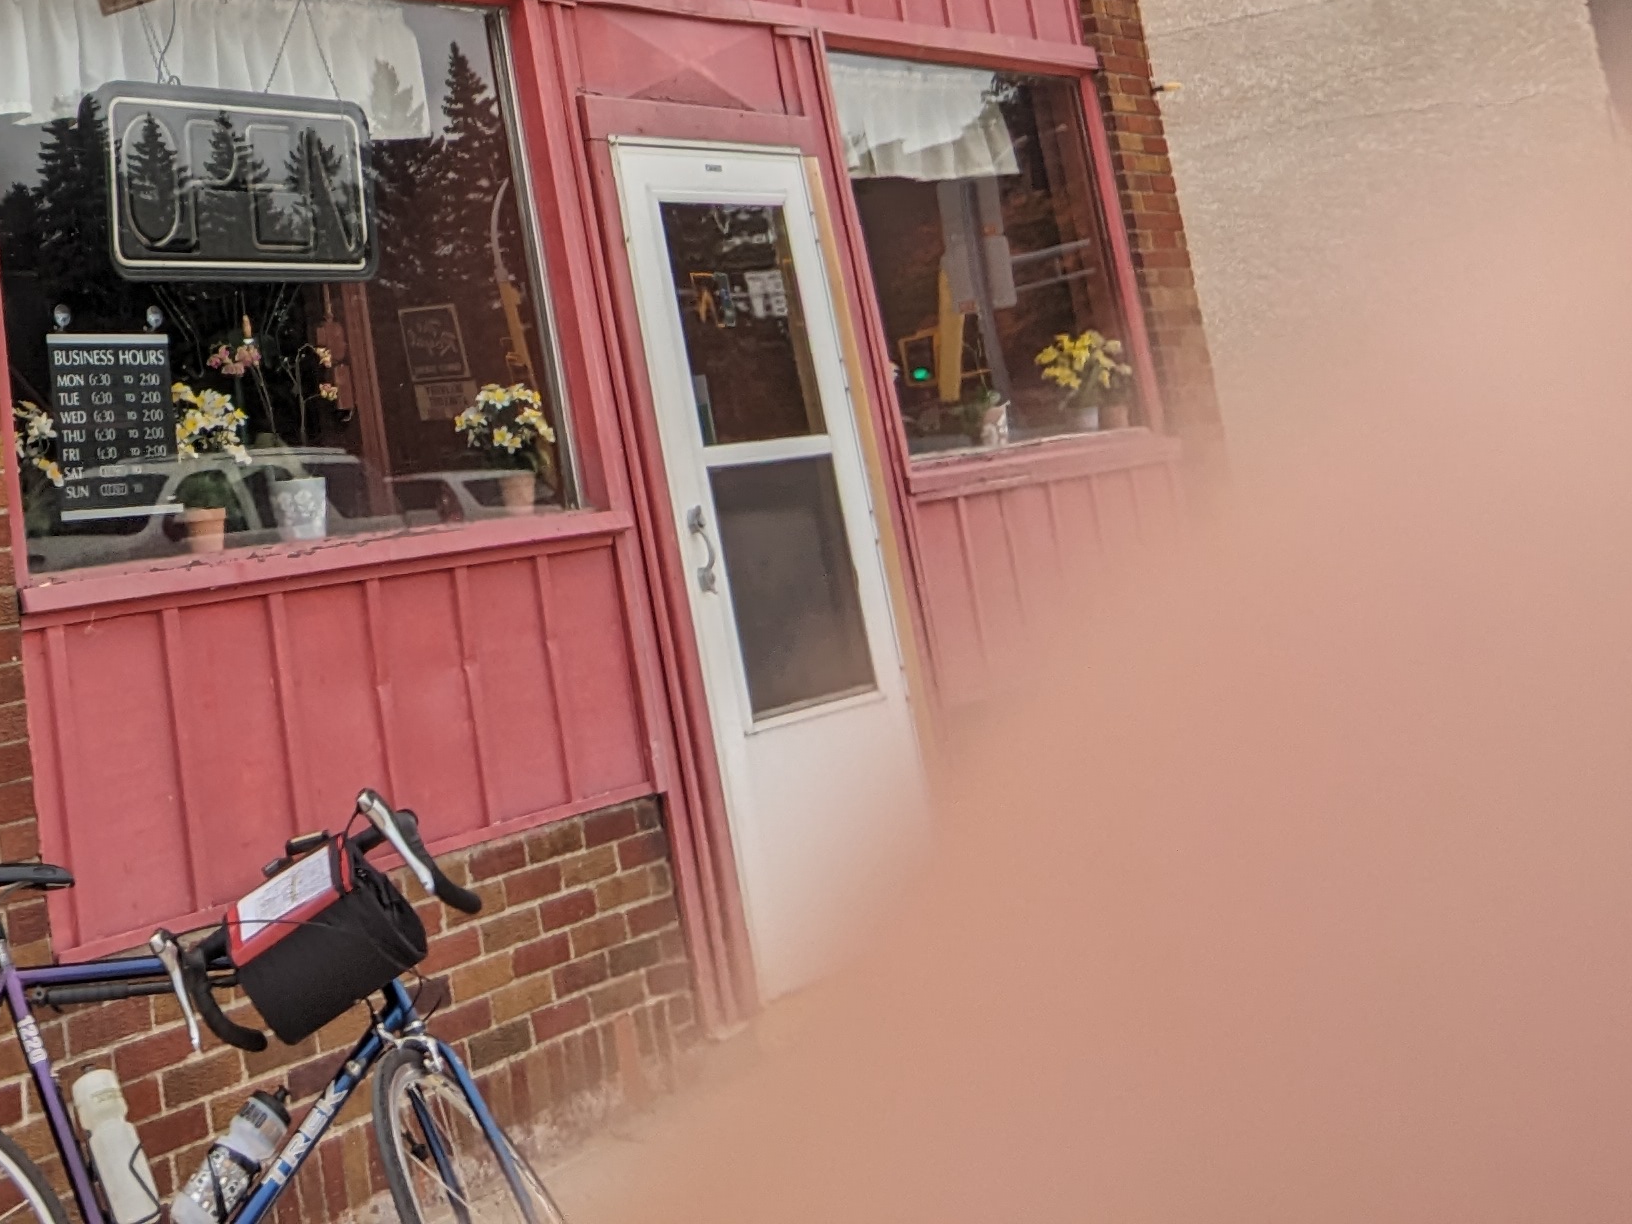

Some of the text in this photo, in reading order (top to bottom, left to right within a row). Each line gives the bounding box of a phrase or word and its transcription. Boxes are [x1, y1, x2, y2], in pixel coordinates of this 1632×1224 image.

[120, 111, 358, 254] OPEN
[53, 349, 165, 366] BUSINESS HOURS
[56, 374, 85, 388] MON
[139, 373, 160, 386] 2:00
[58, 392, 80, 406] TUE
[141, 391, 161, 404] 2:00
[60, 410, 87, 424] WED
[142, 409, 164, 422] 2:00
[61, 429, 86, 443] THU
[143, 427, 165, 440] 2:00
[62, 448, 80, 462] FRI
[63, 466, 84, 480] SAT
[66, 485, 90, 499] SUN
[16, 1015, 48, 1064] 1220
[260, 1080, 350, 1186] TREK
